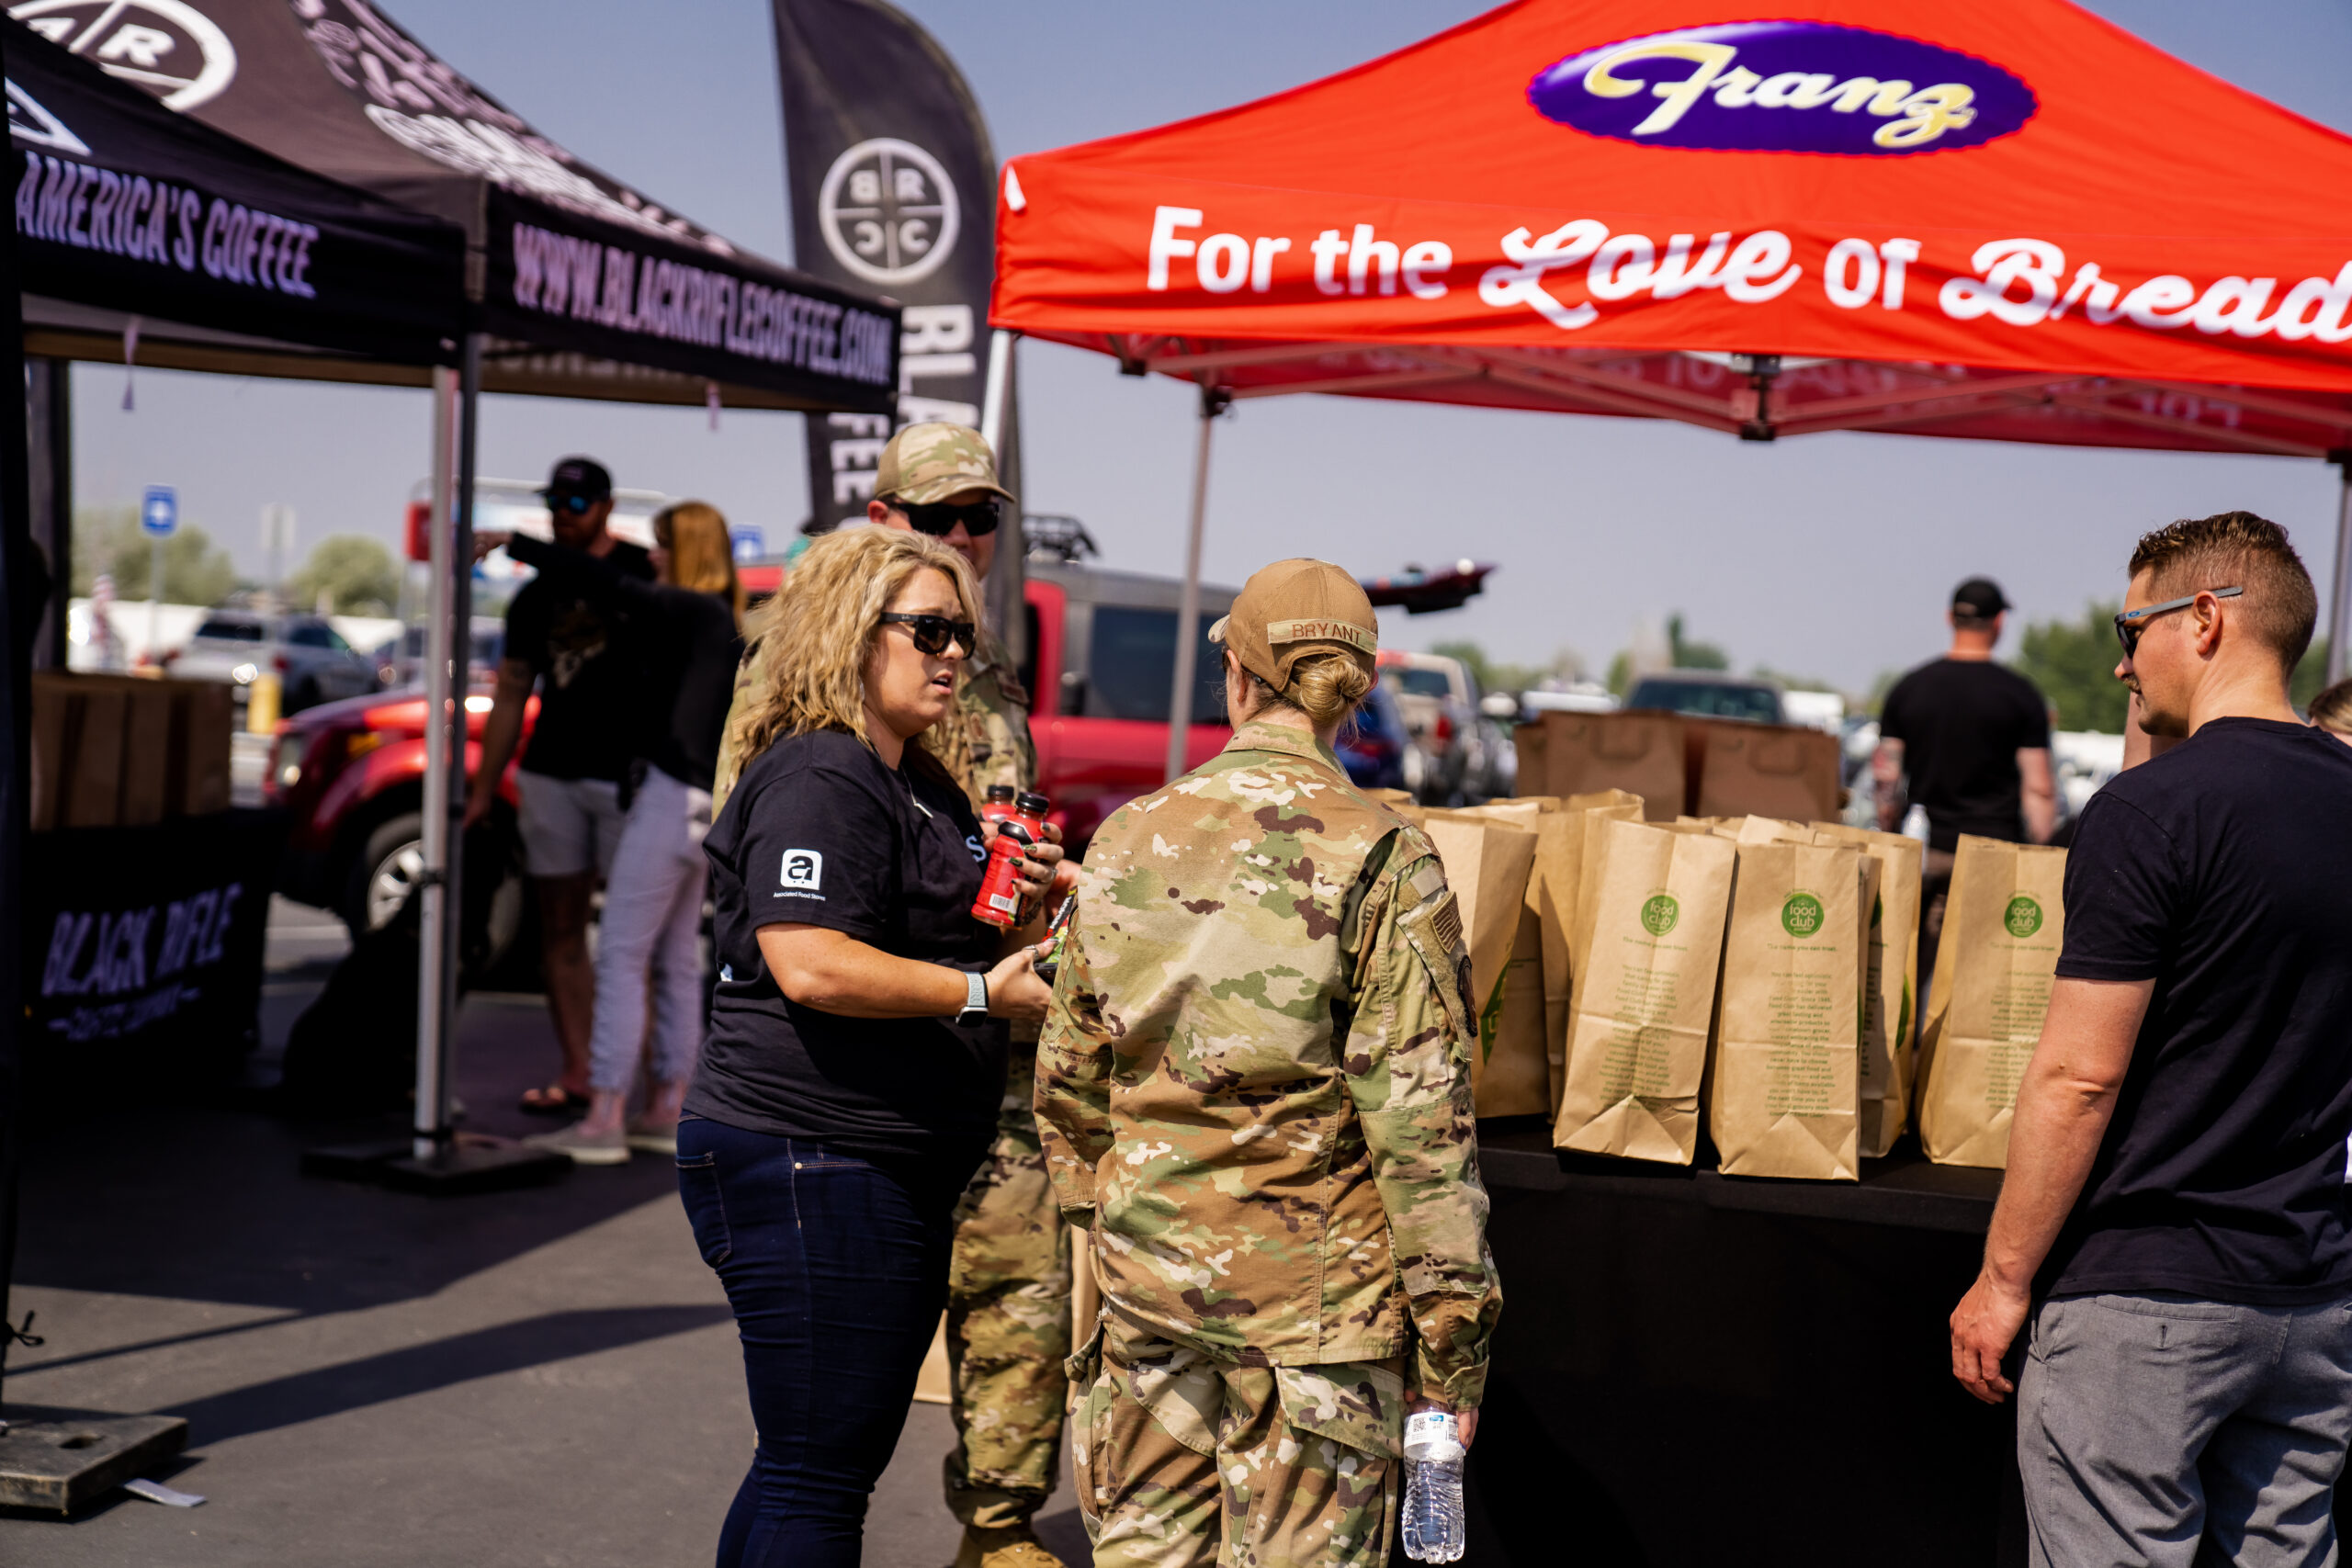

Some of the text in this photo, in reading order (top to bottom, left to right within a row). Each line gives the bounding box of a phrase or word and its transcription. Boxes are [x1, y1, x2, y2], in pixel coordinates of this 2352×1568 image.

[1583, 39, 1978, 148] Franz
[15, 151, 319, 299] AMERICA'S COFFEE
[1146, 205, 1291, 292] For
[1311, 222, 1453, 299] the
[1478, 219, 1802, 329] Love
[1939, 237, 2352, 343] Bread
[1292, 622, 1363, 646] BRYANT
[1650, 900, 1674, 915] food
[1790, 903, 1816, 916] food
[2011, 905, 2036, 917] food
[1648, 912, 1671, 927] club
[1790, 915, 1815, 927] club
[2011, 916, 2035, 927] club
